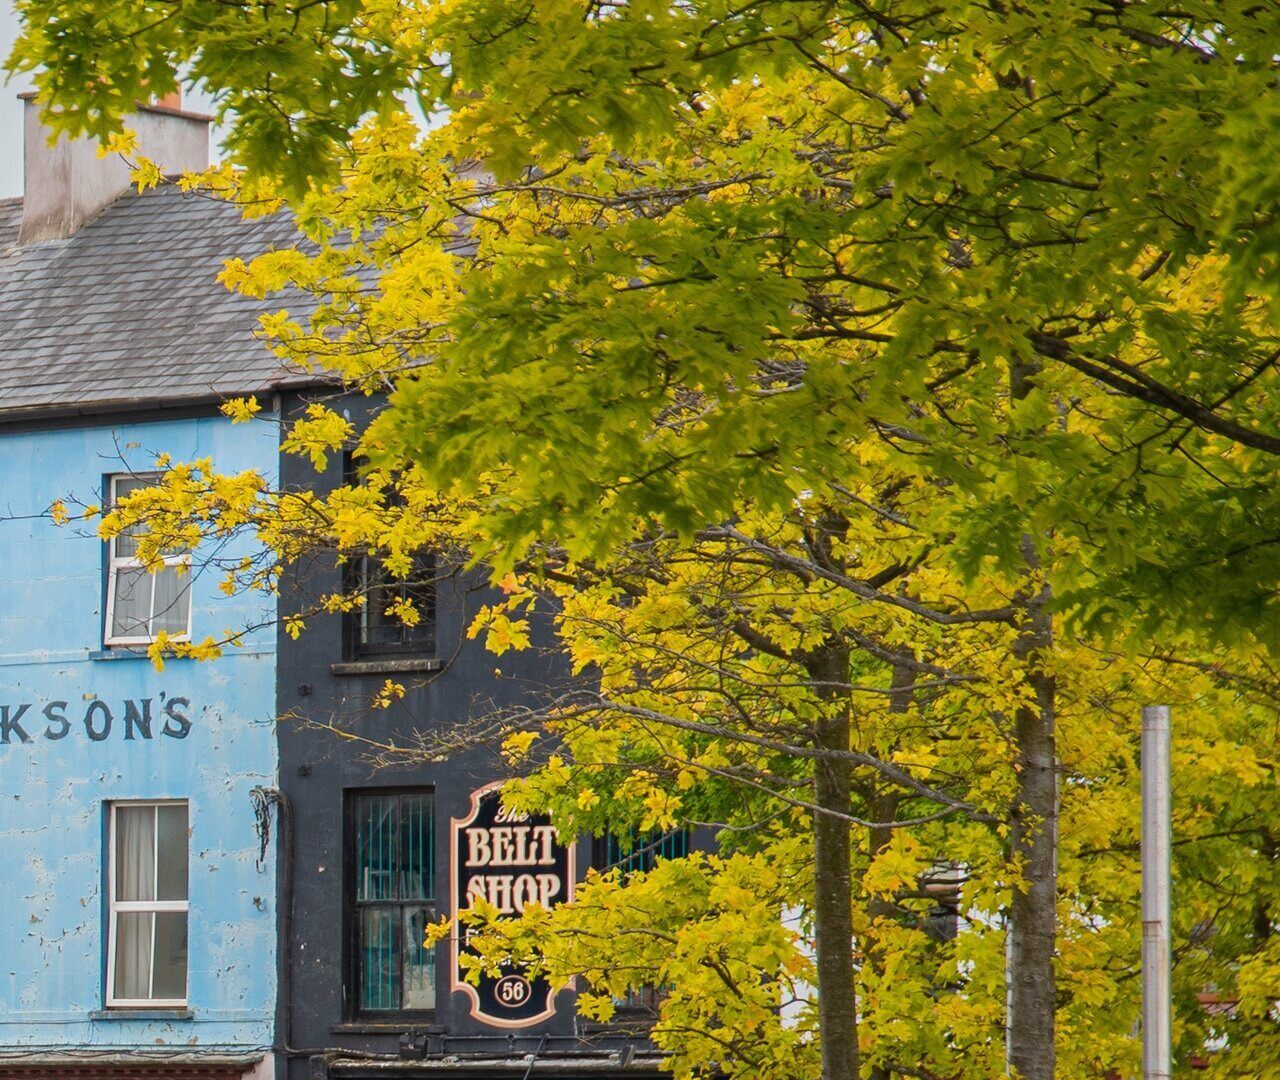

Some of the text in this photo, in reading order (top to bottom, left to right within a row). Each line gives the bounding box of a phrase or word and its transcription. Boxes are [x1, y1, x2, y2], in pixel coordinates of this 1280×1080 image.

[493, 803, 530, 823] The
[465, 825, 559, 866] BELT
[466, 873, 561, 914] SHOP
[502, 982, 524, 1001] 56
